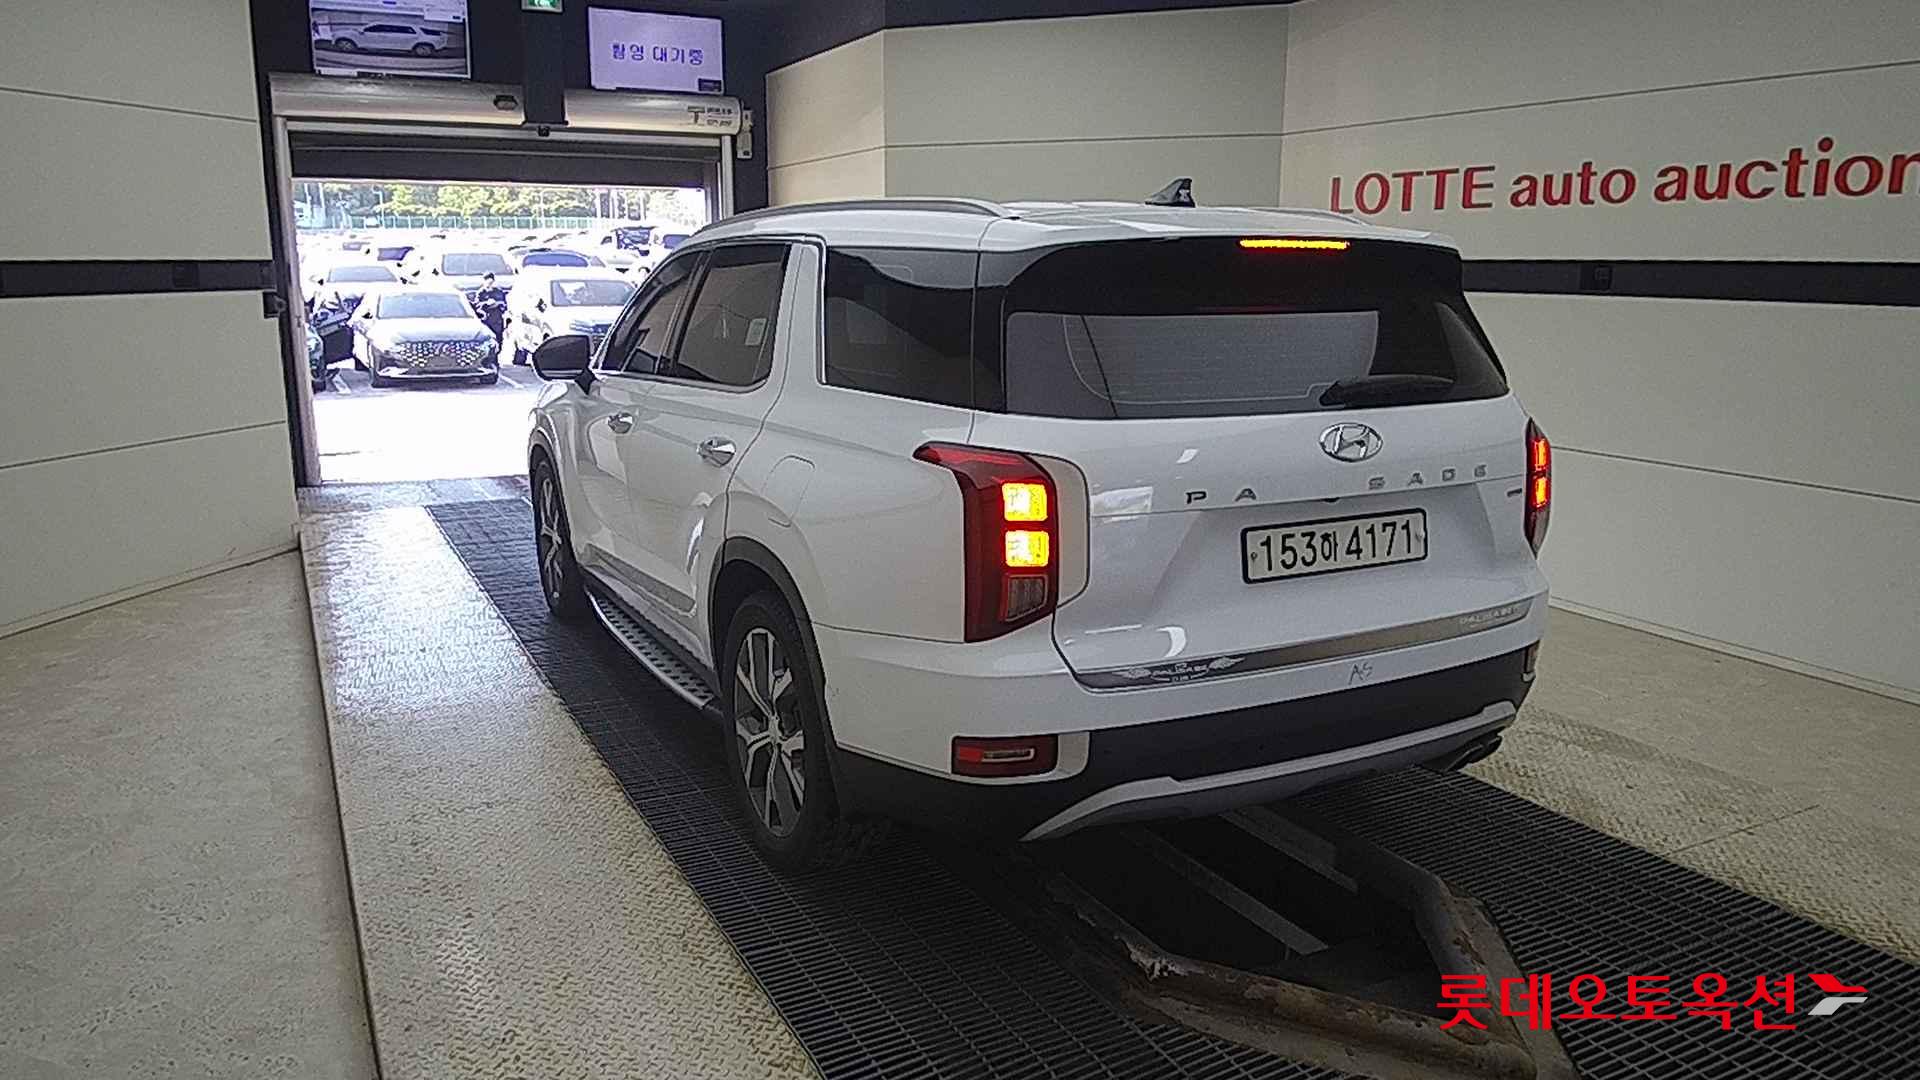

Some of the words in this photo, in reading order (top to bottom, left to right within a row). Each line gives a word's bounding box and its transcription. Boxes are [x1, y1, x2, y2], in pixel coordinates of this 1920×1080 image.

[652, 45, 704, 66] 대기중
[1330, 165, 1495, 215] LOTTE
[1509, 161, 1637, 208] auto
